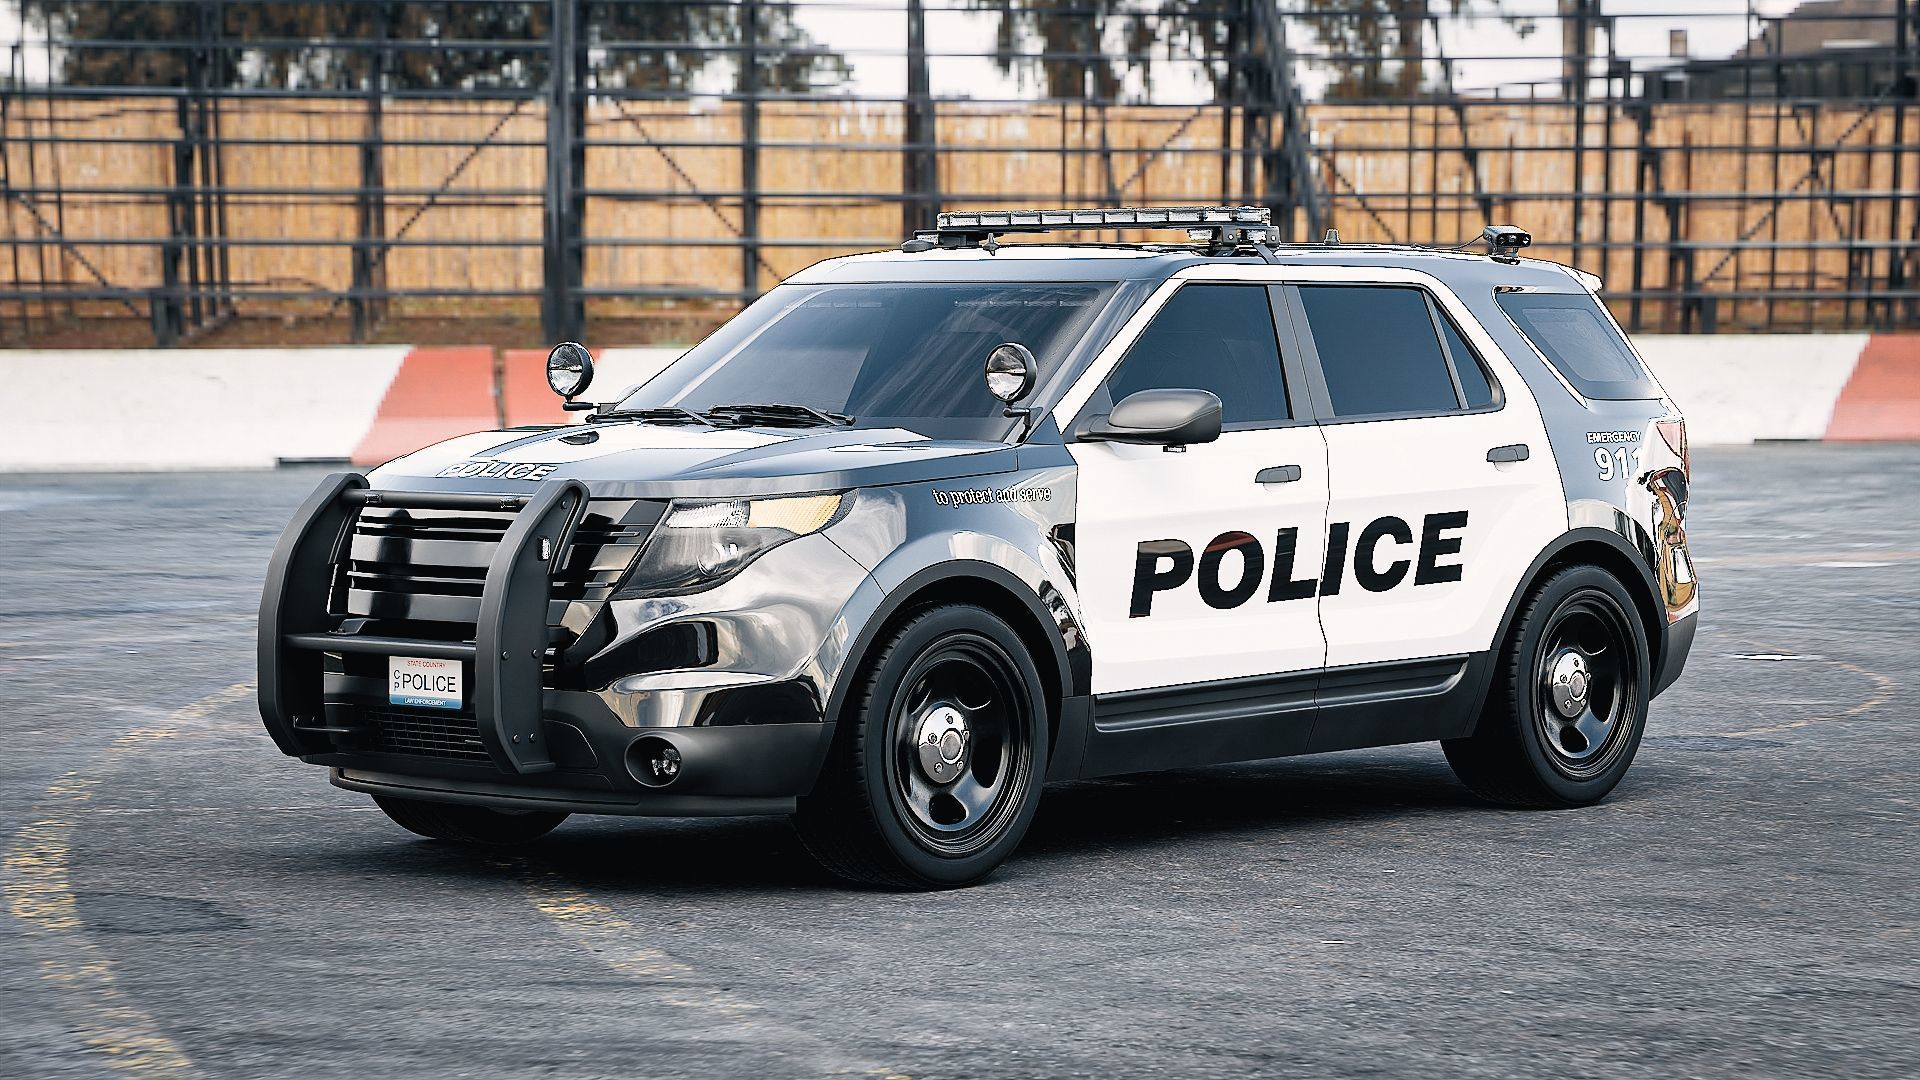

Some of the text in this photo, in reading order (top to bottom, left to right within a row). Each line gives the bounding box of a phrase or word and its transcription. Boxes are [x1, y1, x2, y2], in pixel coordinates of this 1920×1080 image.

[1586, 431, 1641, 444] EMERGENCY
[435, 460, 558, 481] POLICE
[932, 487, 1051, 509] to protect and serve
[1129, 510, 1469, 618] POLICE
[402, 673, 457, 693] POLICE
